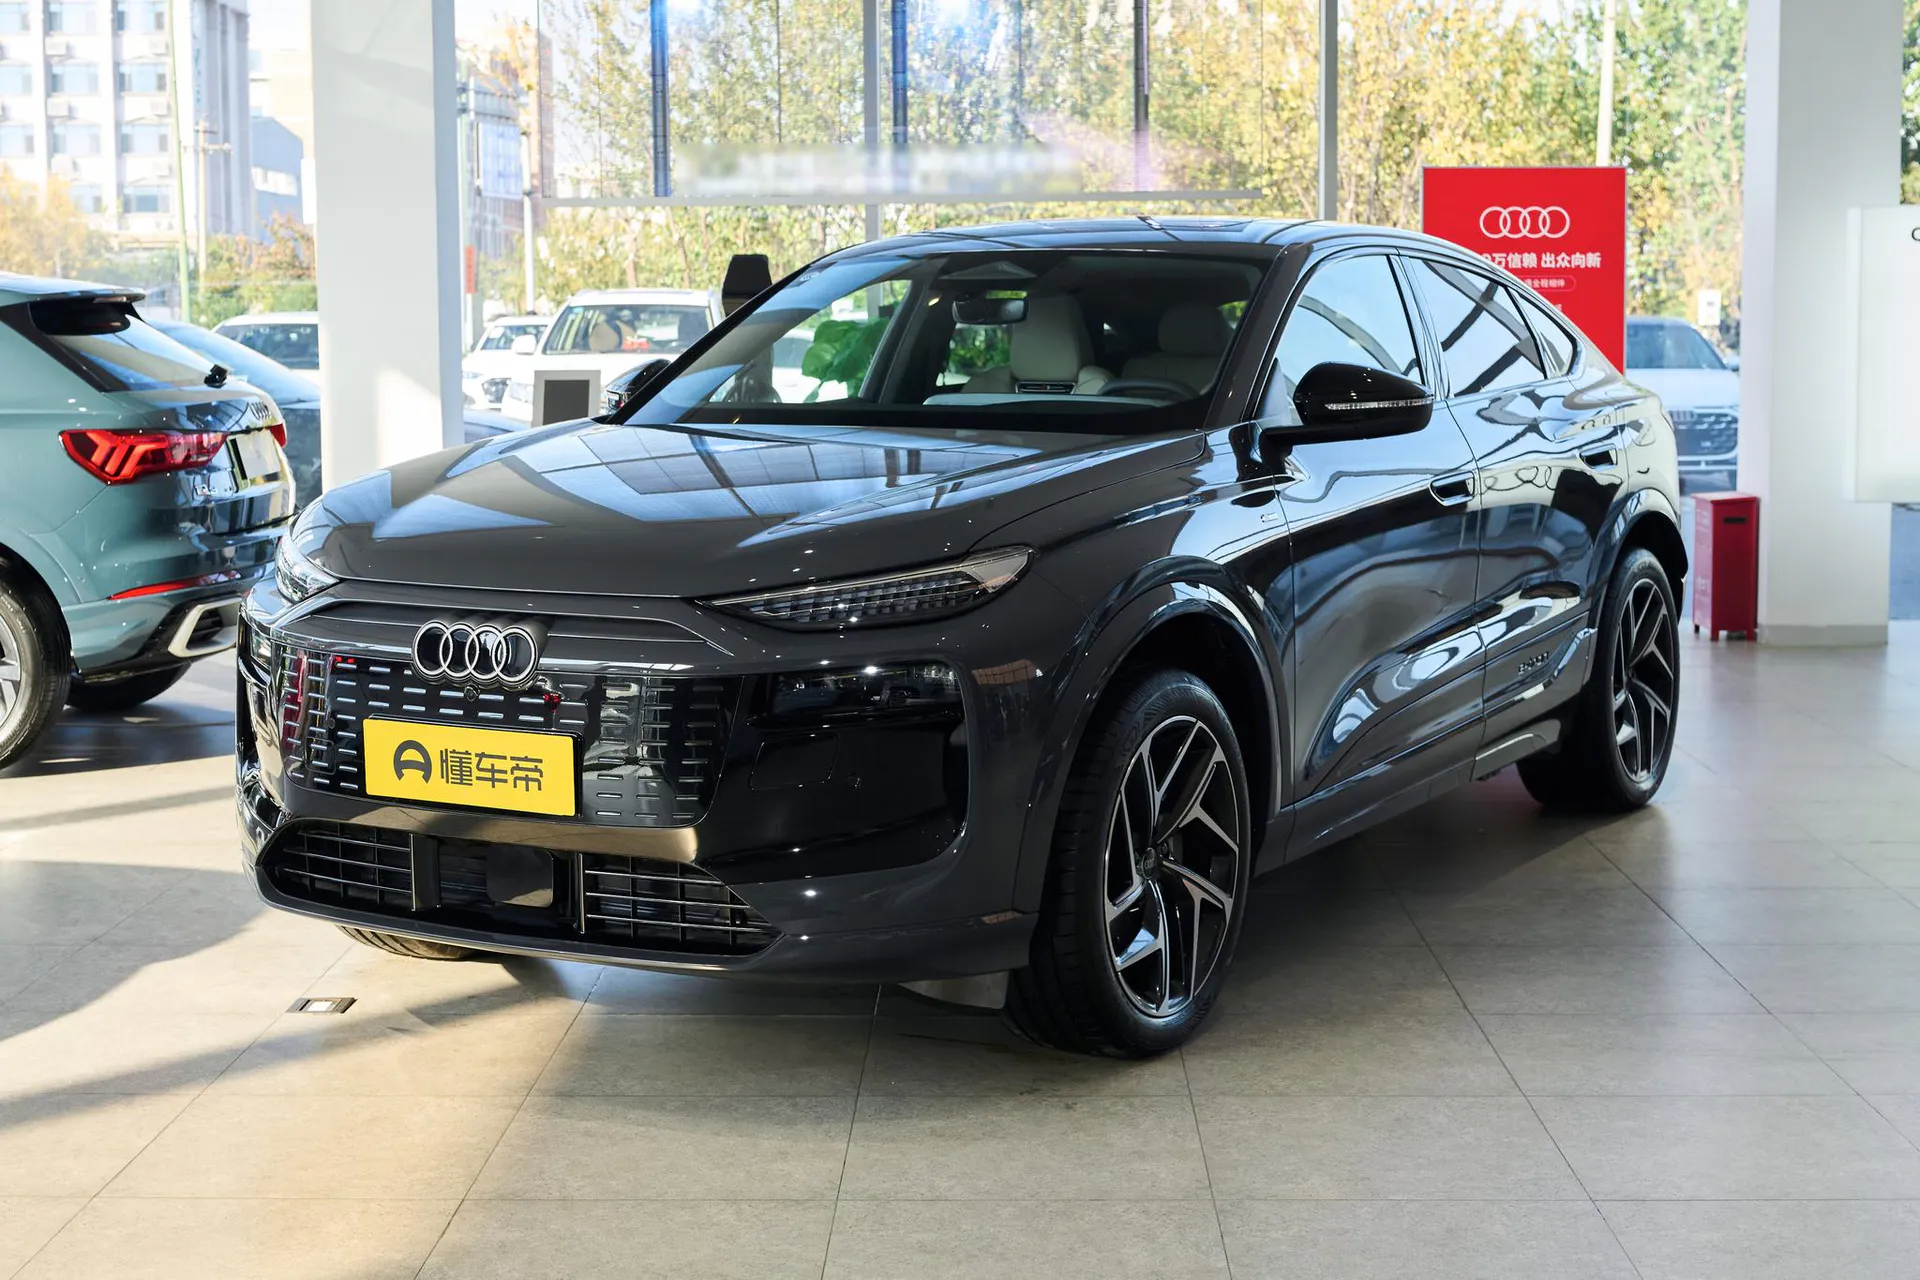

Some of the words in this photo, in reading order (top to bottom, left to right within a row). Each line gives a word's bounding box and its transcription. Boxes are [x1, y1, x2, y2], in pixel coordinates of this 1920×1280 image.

[1541, 251, 1602, 269] 出众向新
[439, 748, 544, 792] 懂车帝
